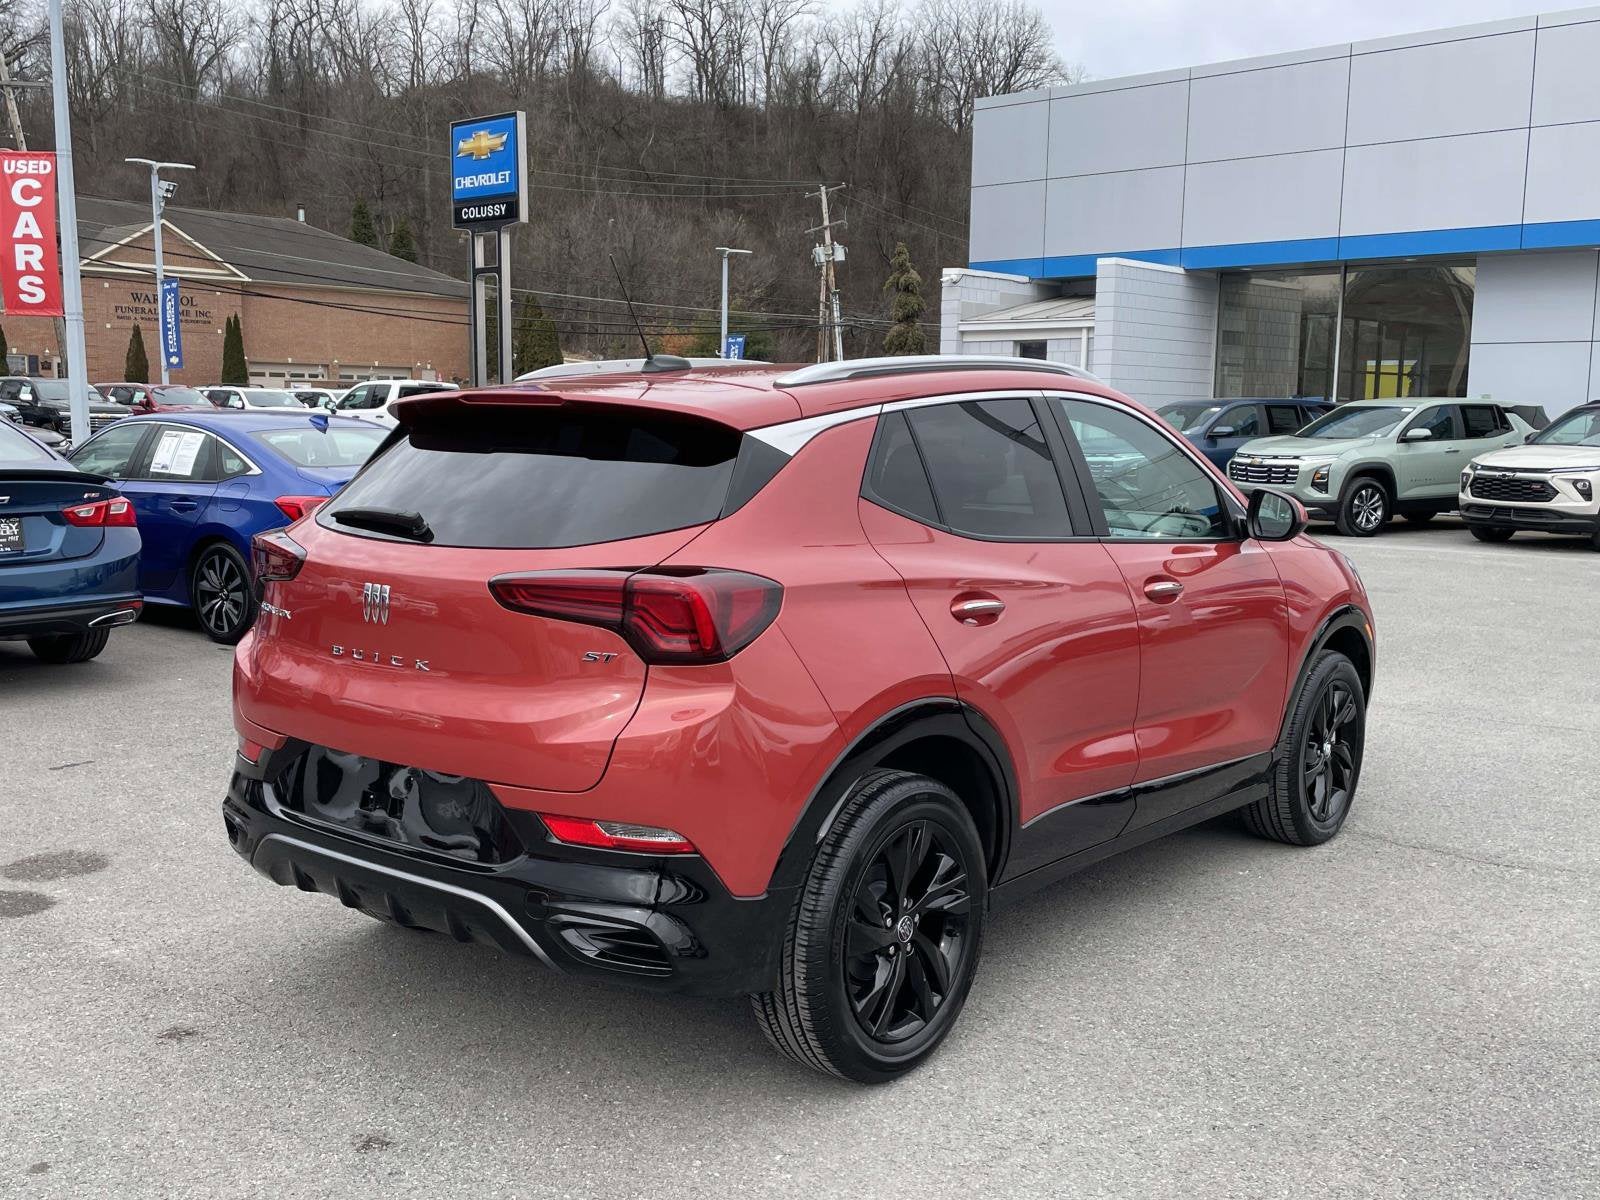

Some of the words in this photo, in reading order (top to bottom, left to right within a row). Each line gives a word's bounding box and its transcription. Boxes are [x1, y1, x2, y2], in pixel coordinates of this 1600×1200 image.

[3, 160, 52, 174] USED
[455, 171, 511, 189] CHEVROLET
[461, 204, 507, 219] COLUSSY
[11, 178, 46, 303] CARS
[130, 292, 198, 307] WAROL
[115, 306, 158, 316] FUNERAL
[332, 645, 430, 671] BUICK
[582, 651, 618, 663] ST
